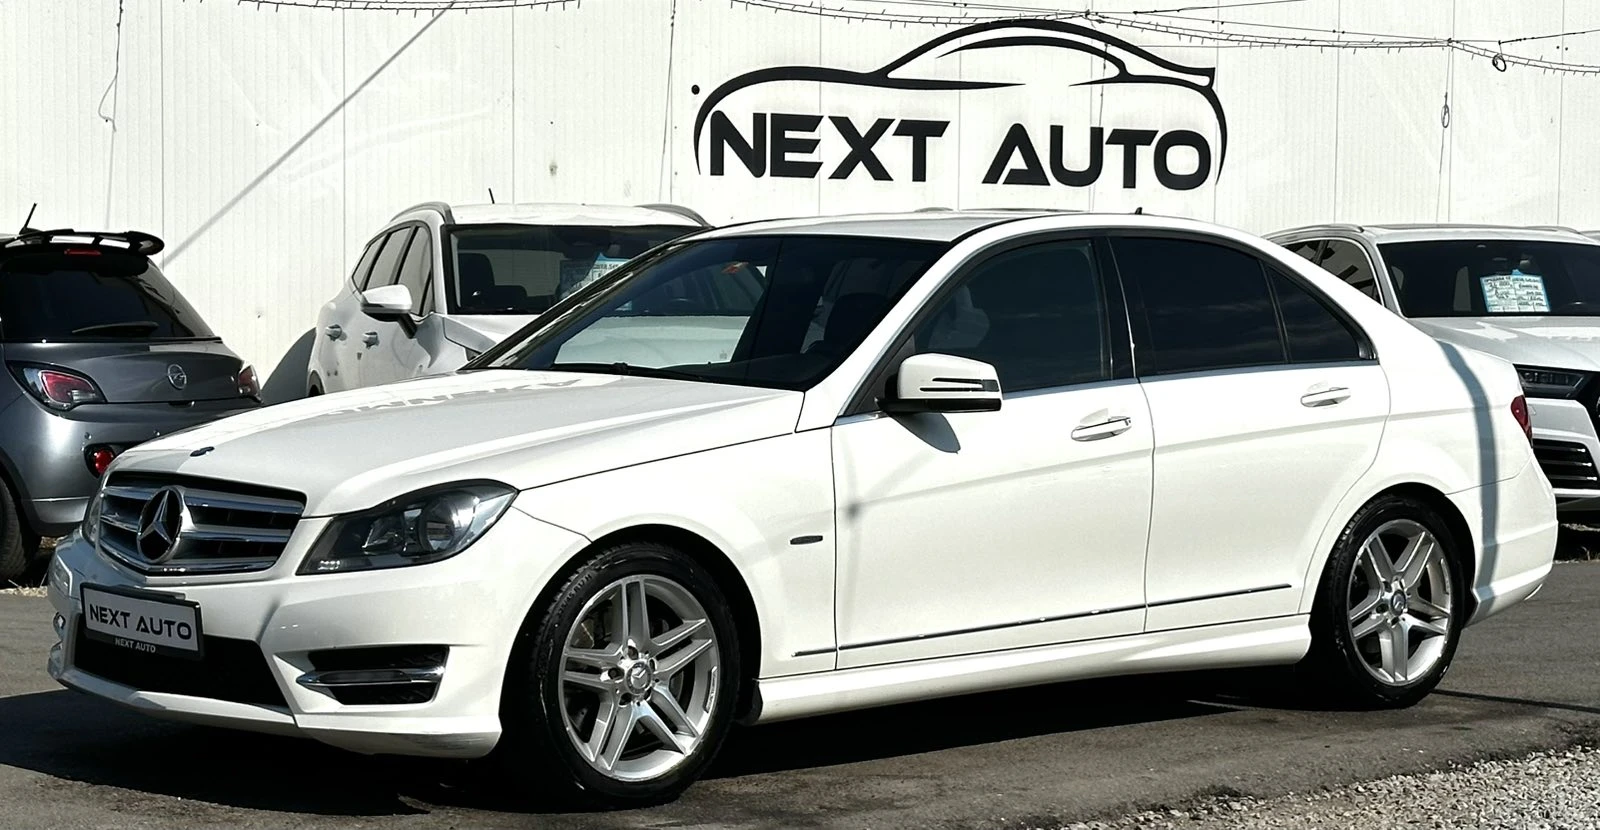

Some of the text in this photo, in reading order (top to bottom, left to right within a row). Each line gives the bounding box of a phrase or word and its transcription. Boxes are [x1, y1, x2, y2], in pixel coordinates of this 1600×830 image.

[709, 110, 1212, 191] NEXT AUTO
[89, 603, 192, 641] NEXT AUTO
[114, 638, 157, 653] NEXT AUTO
